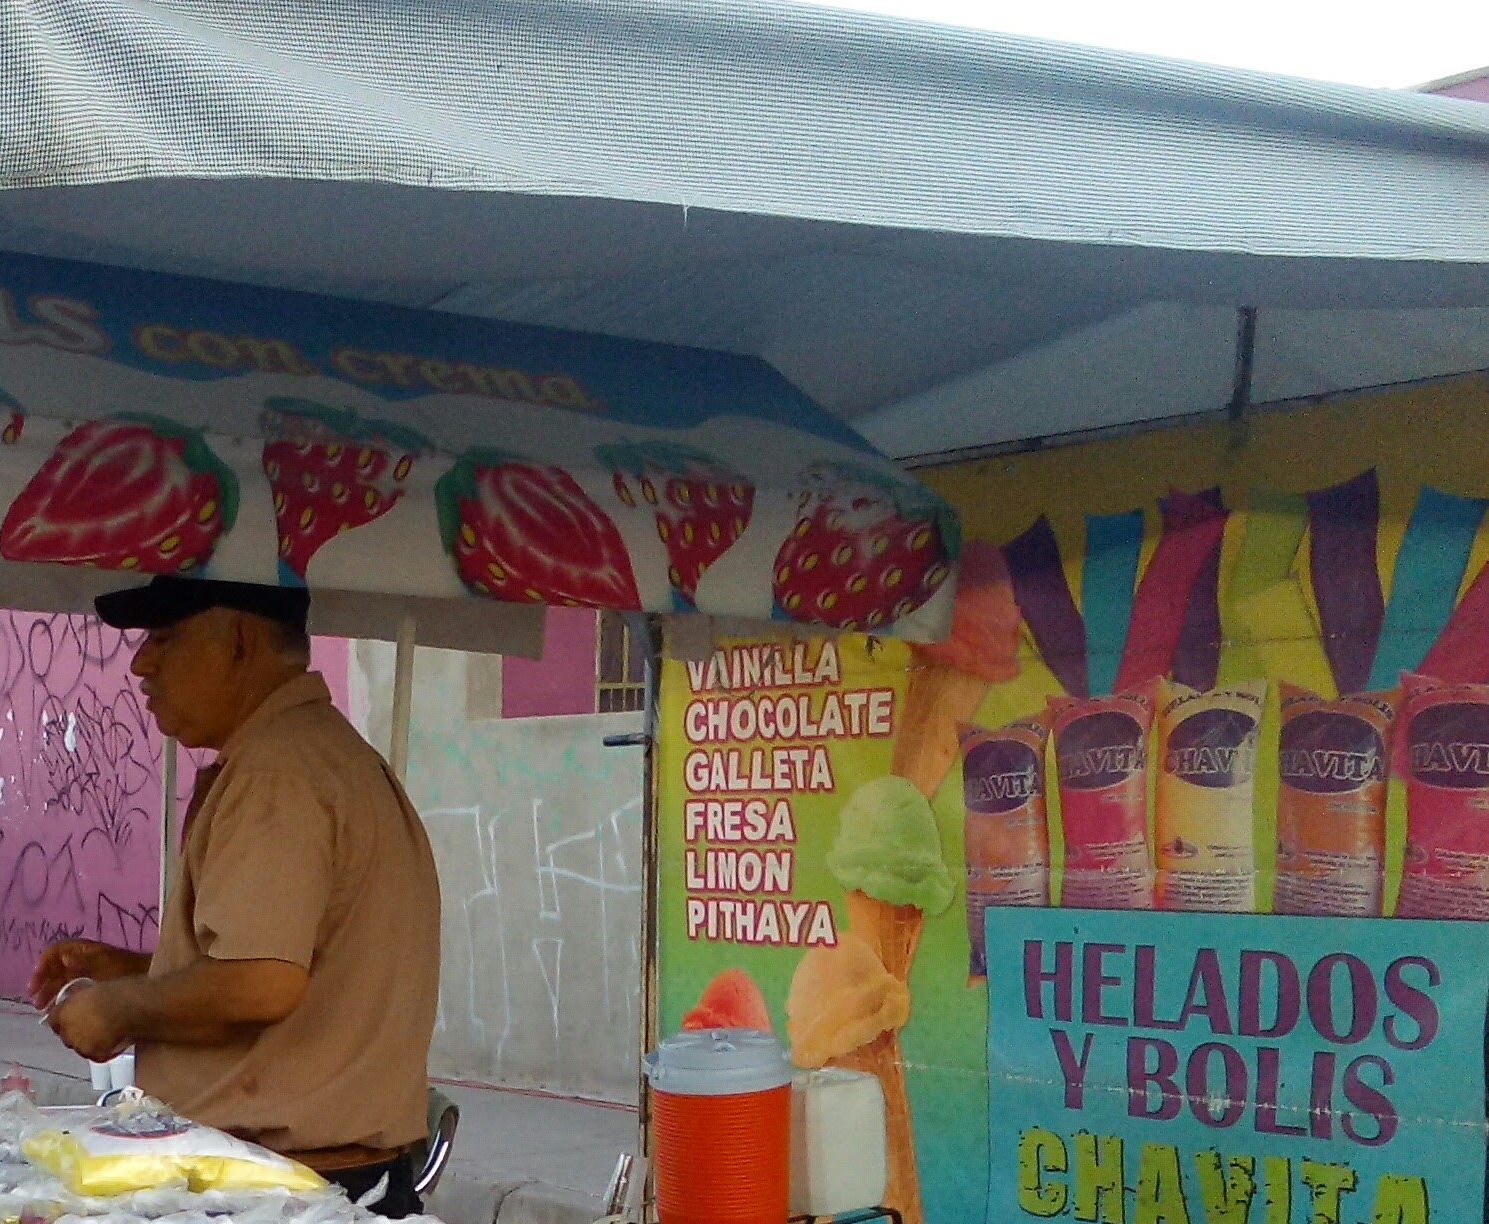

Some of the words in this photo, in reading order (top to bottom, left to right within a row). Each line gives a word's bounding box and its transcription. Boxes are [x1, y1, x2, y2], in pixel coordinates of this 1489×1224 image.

[132, 319, 314, 374] con
[330, 344, 604, 410] crema
[686, 640, 841, 692] VAINILLA
[685, 689, 894, 742] CHOCOLATE
[685, 747, 835, 791] GALLETA
[685, 799, 796, 843] FRESA
[685, 850, 792, 892] LIMON
[686, 898, 838, 945] PITHAYA
[1022, 939, 1442, 1051] HELADOS
[1050, 1027, 1095, 1110] Y
[1126, 1035, 1399, 1147] BOLIS
